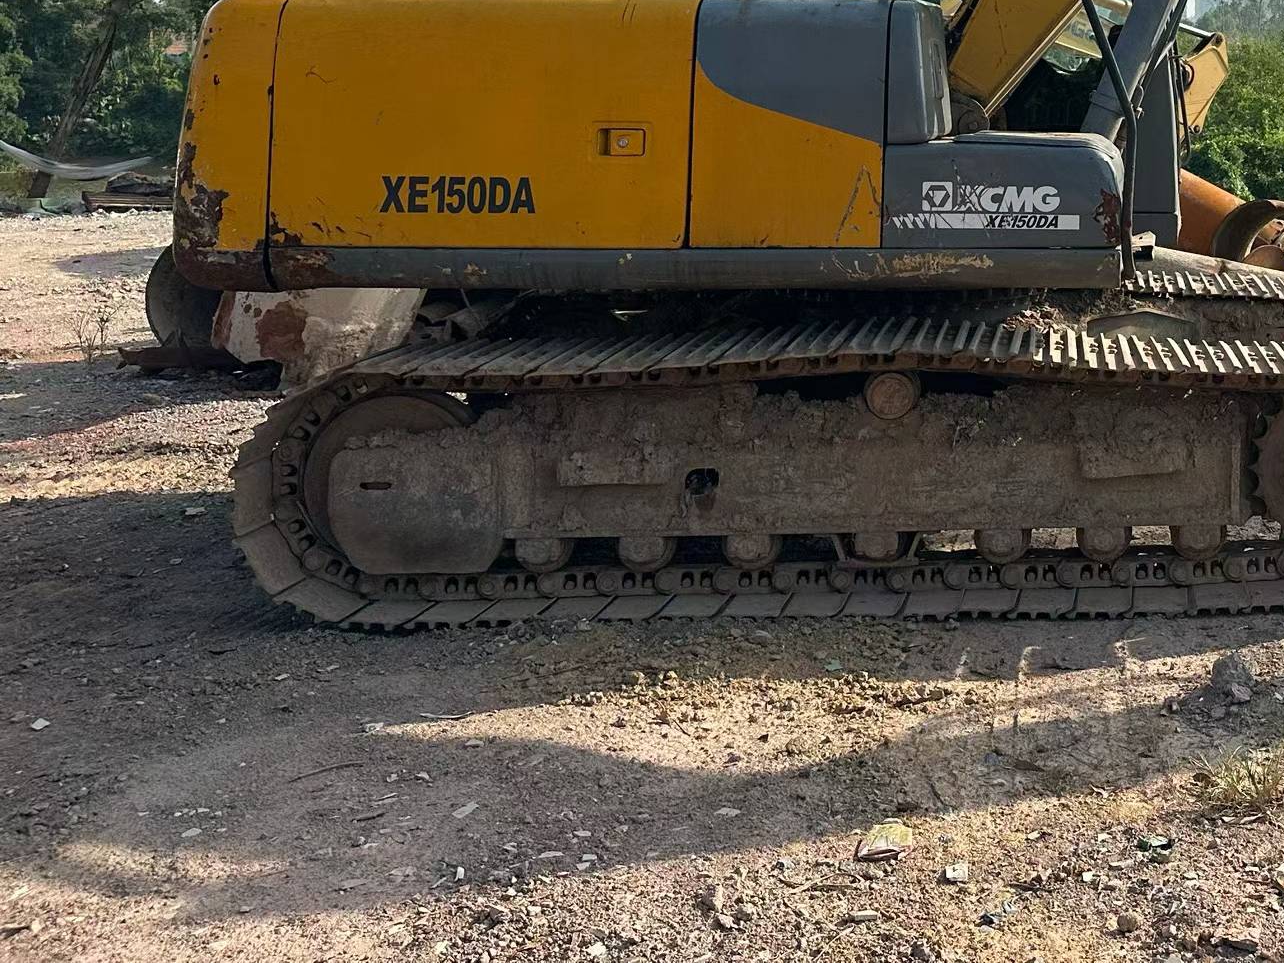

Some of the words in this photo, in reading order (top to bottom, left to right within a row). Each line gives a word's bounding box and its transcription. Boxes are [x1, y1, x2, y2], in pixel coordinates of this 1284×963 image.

[379, 175, 536, 214] XE150DA
[952, 185, 1061, 213] XCMG
[985, 214, 1060, 229] XE150DA
